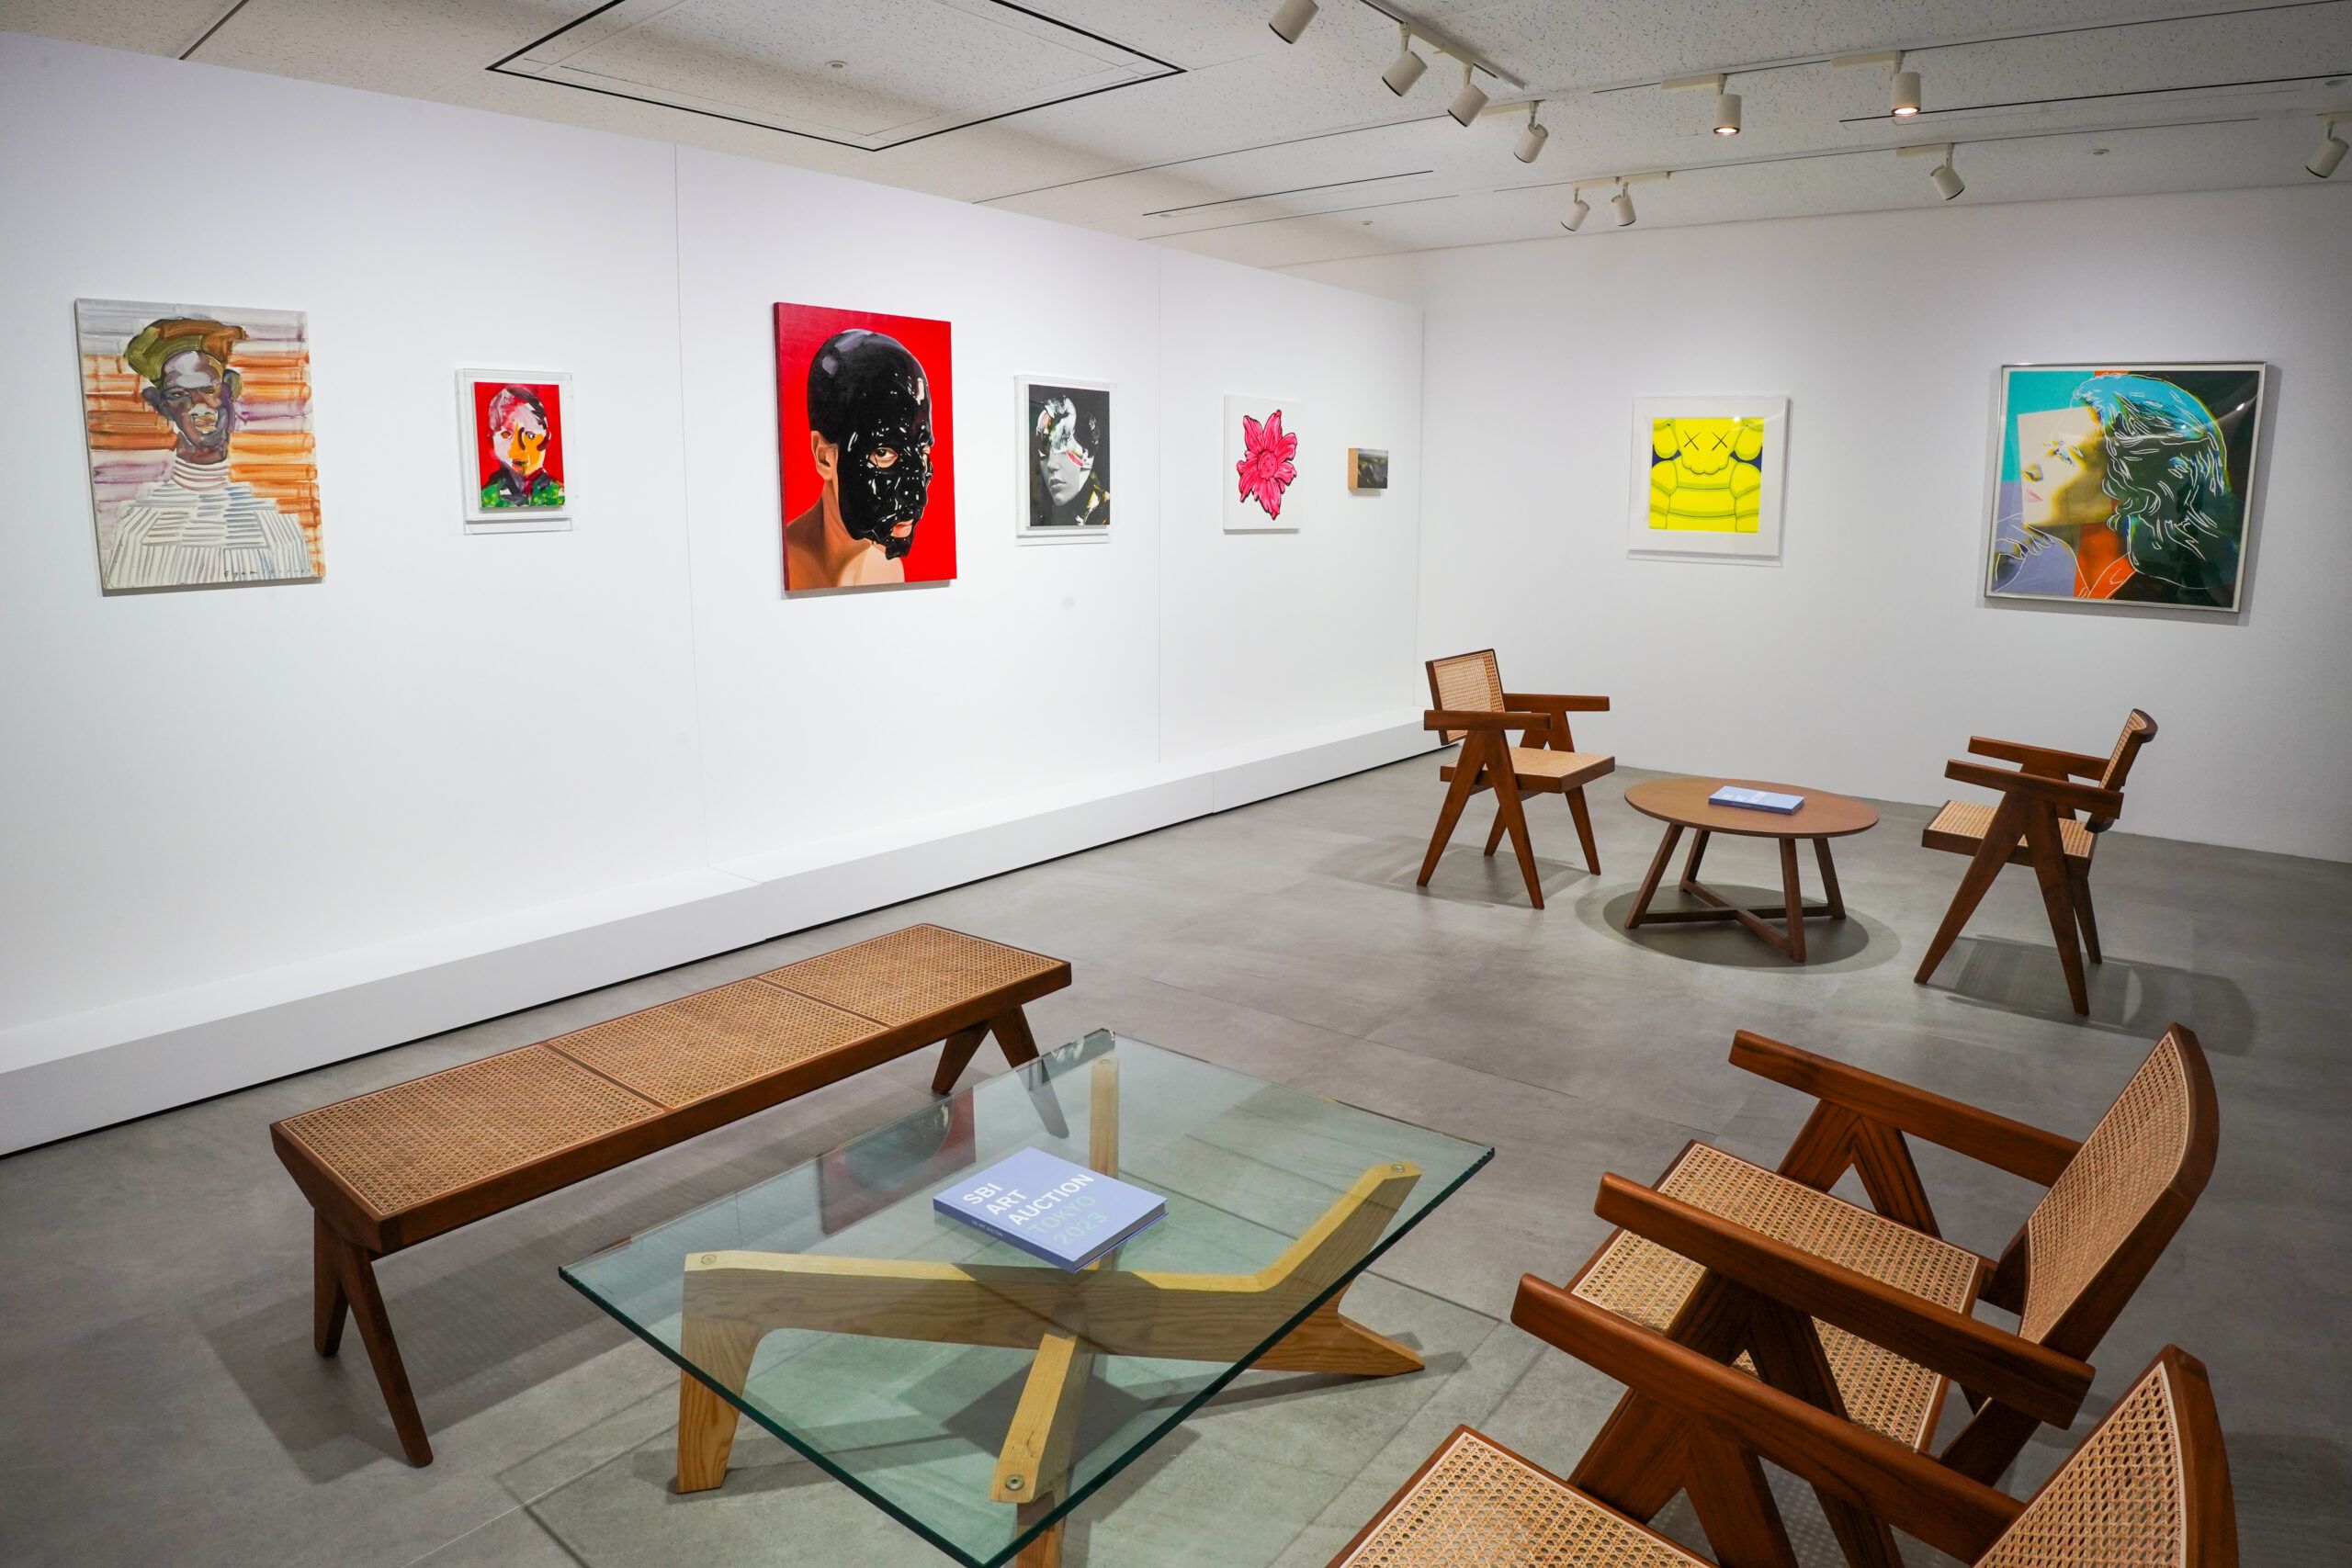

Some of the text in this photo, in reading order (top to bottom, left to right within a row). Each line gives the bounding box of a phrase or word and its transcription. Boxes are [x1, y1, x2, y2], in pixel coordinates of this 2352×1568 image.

[963, 1183, 1003, 1204] SBI
[986, 1190, 1027, 1215] ART
[1008, 1174, 1094, 1225] AUCTION
[1028, 1196, 1095, 1234] TOKYO
[1054, 1212, 1108, 1245] 2023
